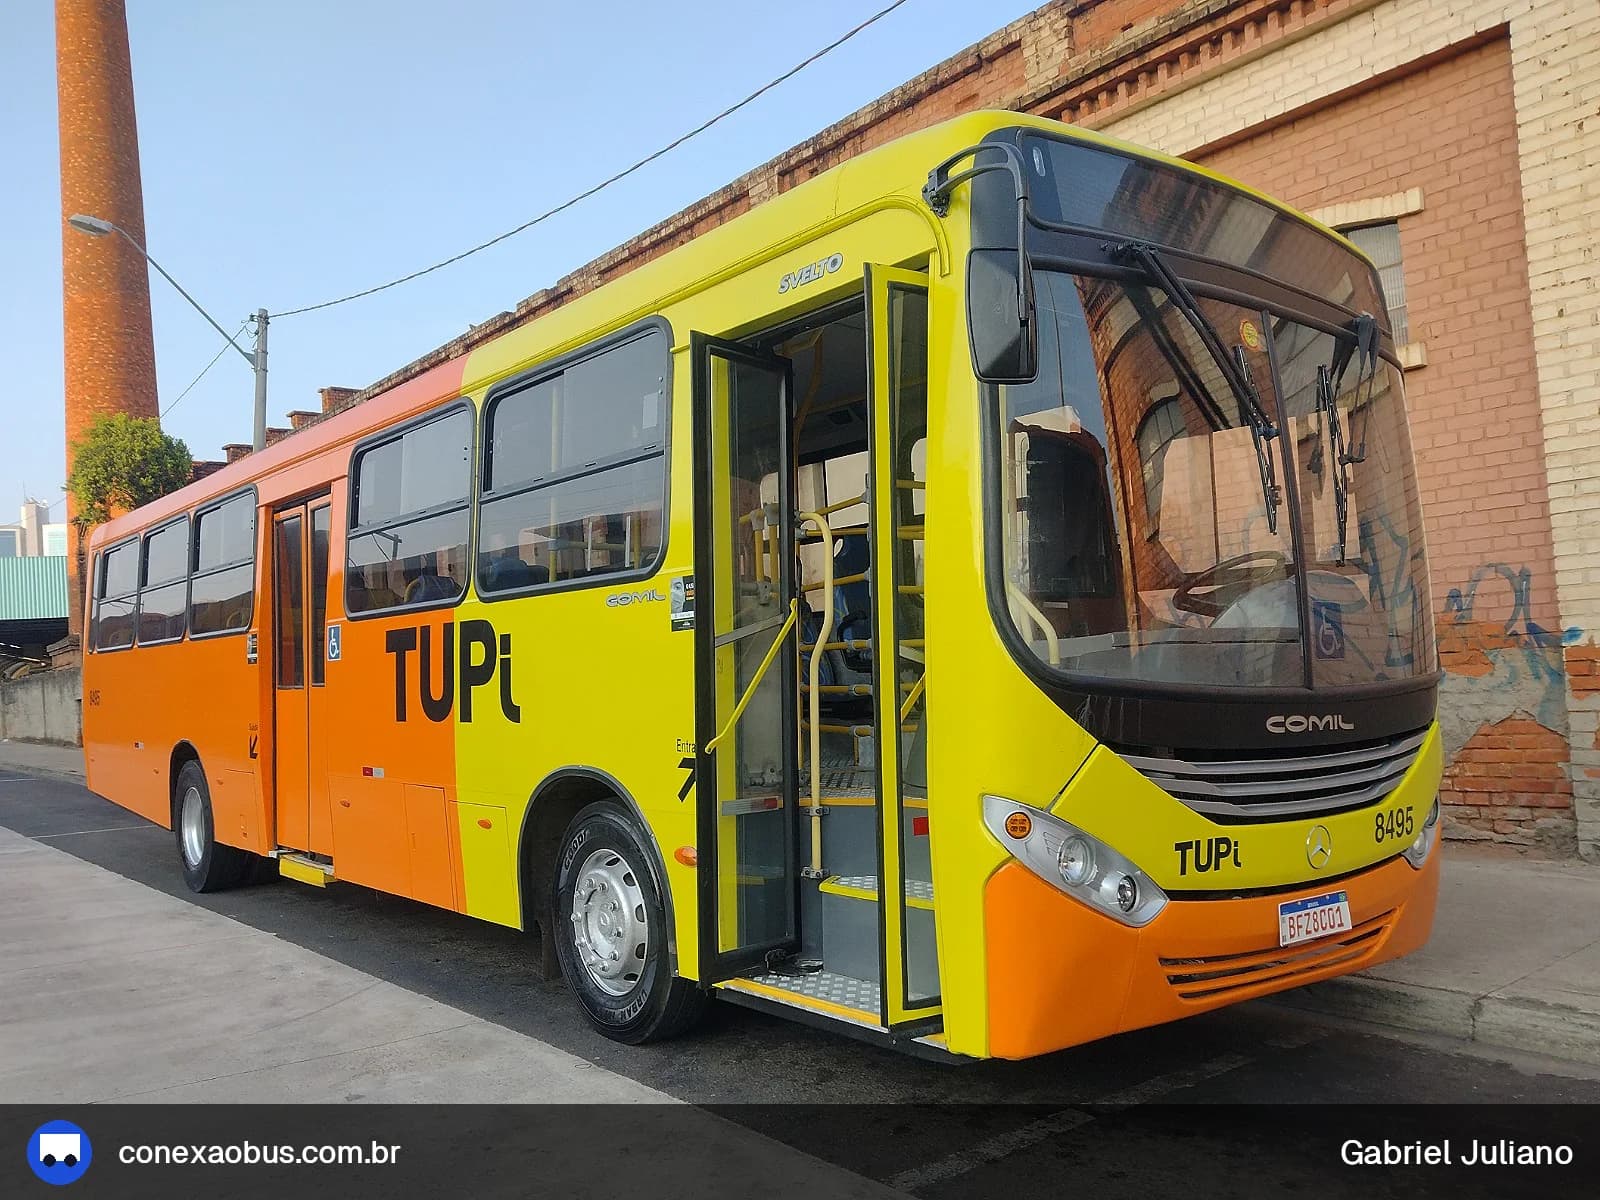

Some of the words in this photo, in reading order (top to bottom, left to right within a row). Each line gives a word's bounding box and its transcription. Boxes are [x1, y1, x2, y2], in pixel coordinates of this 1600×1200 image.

[778, 252, 843, 294] SVELTO
[606, 590, 666, 607] COMIL
[1265, 713, 1354, 734] COMIL
[676, 738, 696, 753] Entra
[1374, 806, 1415, 844] 8495
[1288, 905, 1345, 940] BFZ8C01
